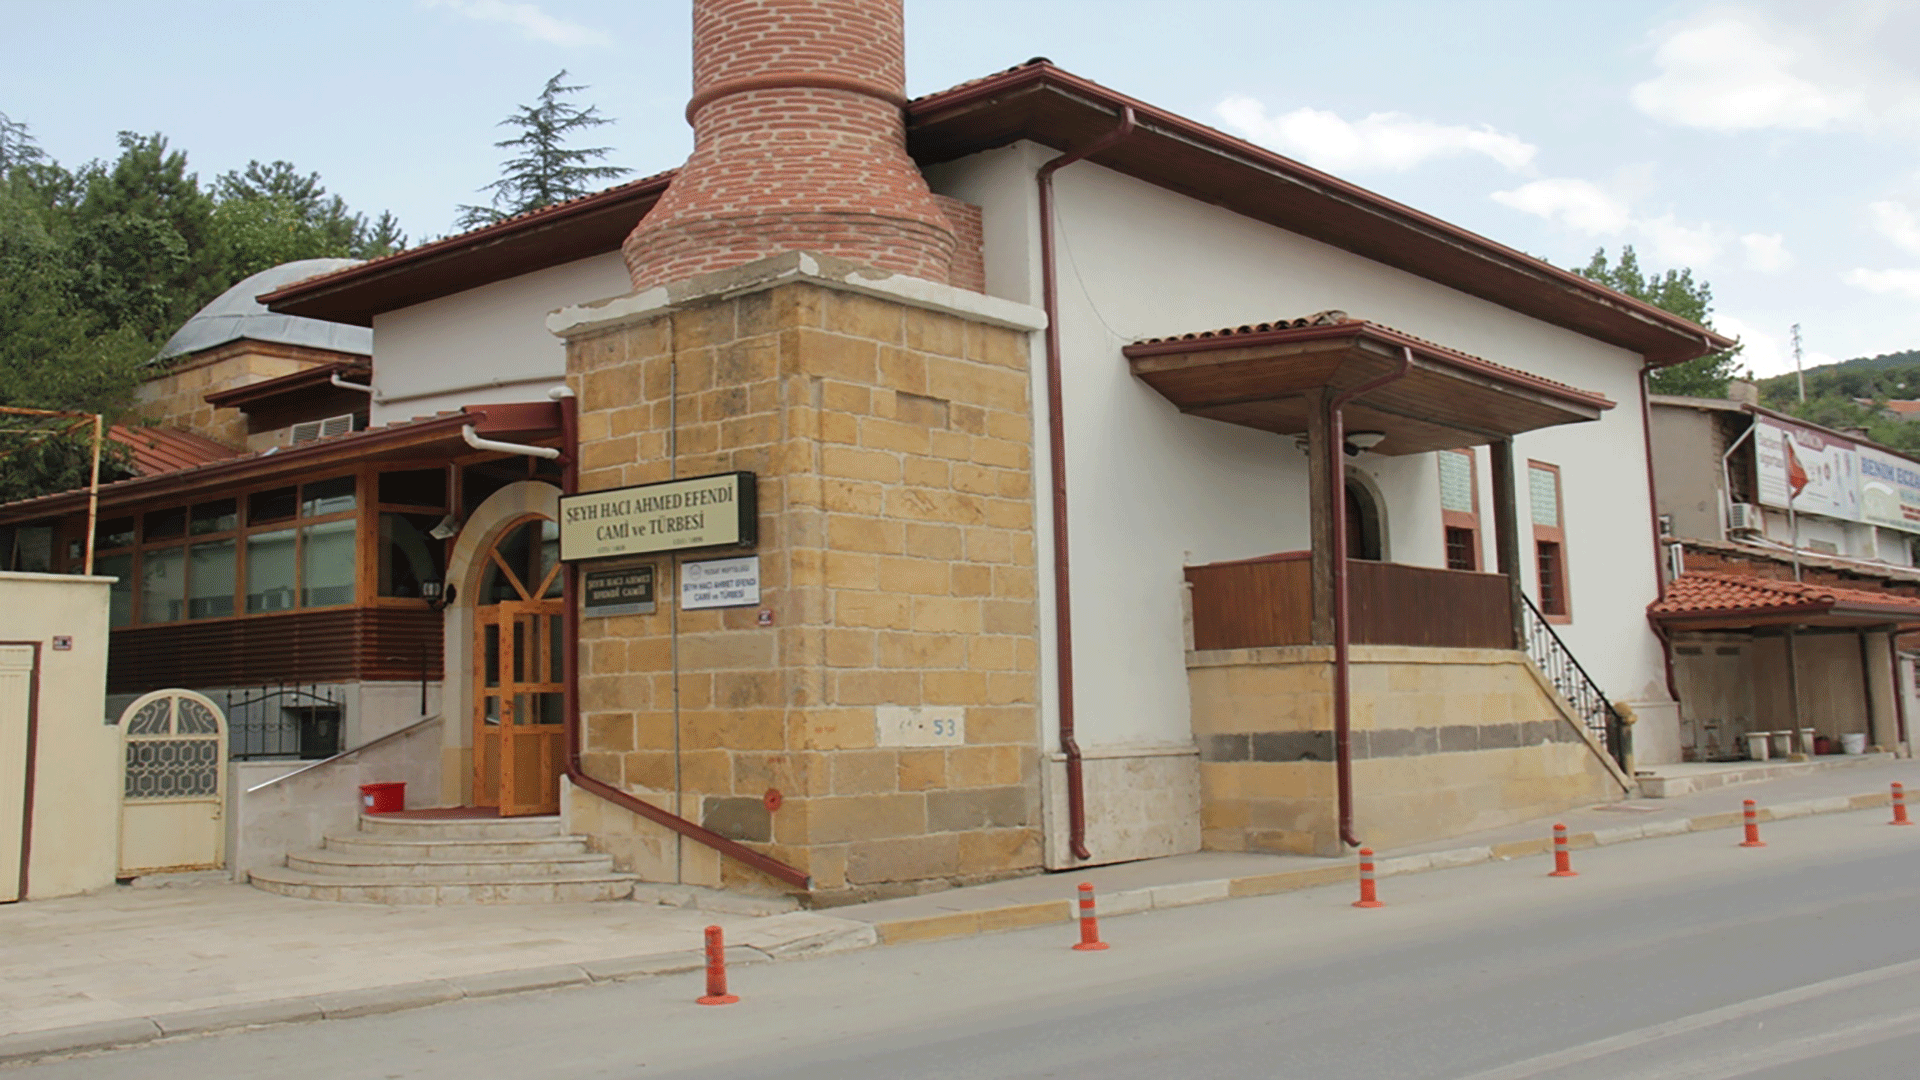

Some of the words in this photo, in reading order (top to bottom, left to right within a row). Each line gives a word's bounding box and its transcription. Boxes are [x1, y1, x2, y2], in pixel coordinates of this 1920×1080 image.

[566, 504, 598, 525] ŞEYH
[600, 499, 631, 518] HACI
[634, 493, 682, 514] AHMED
[684, 484, 733, 507] EFENDİ
[596, 522, 629, 541] CAMİ
[632, 525, 646, 537] ve
[649, 511, 705, 535] TÜRBESİ
[933, 719, 955, 737] 53
